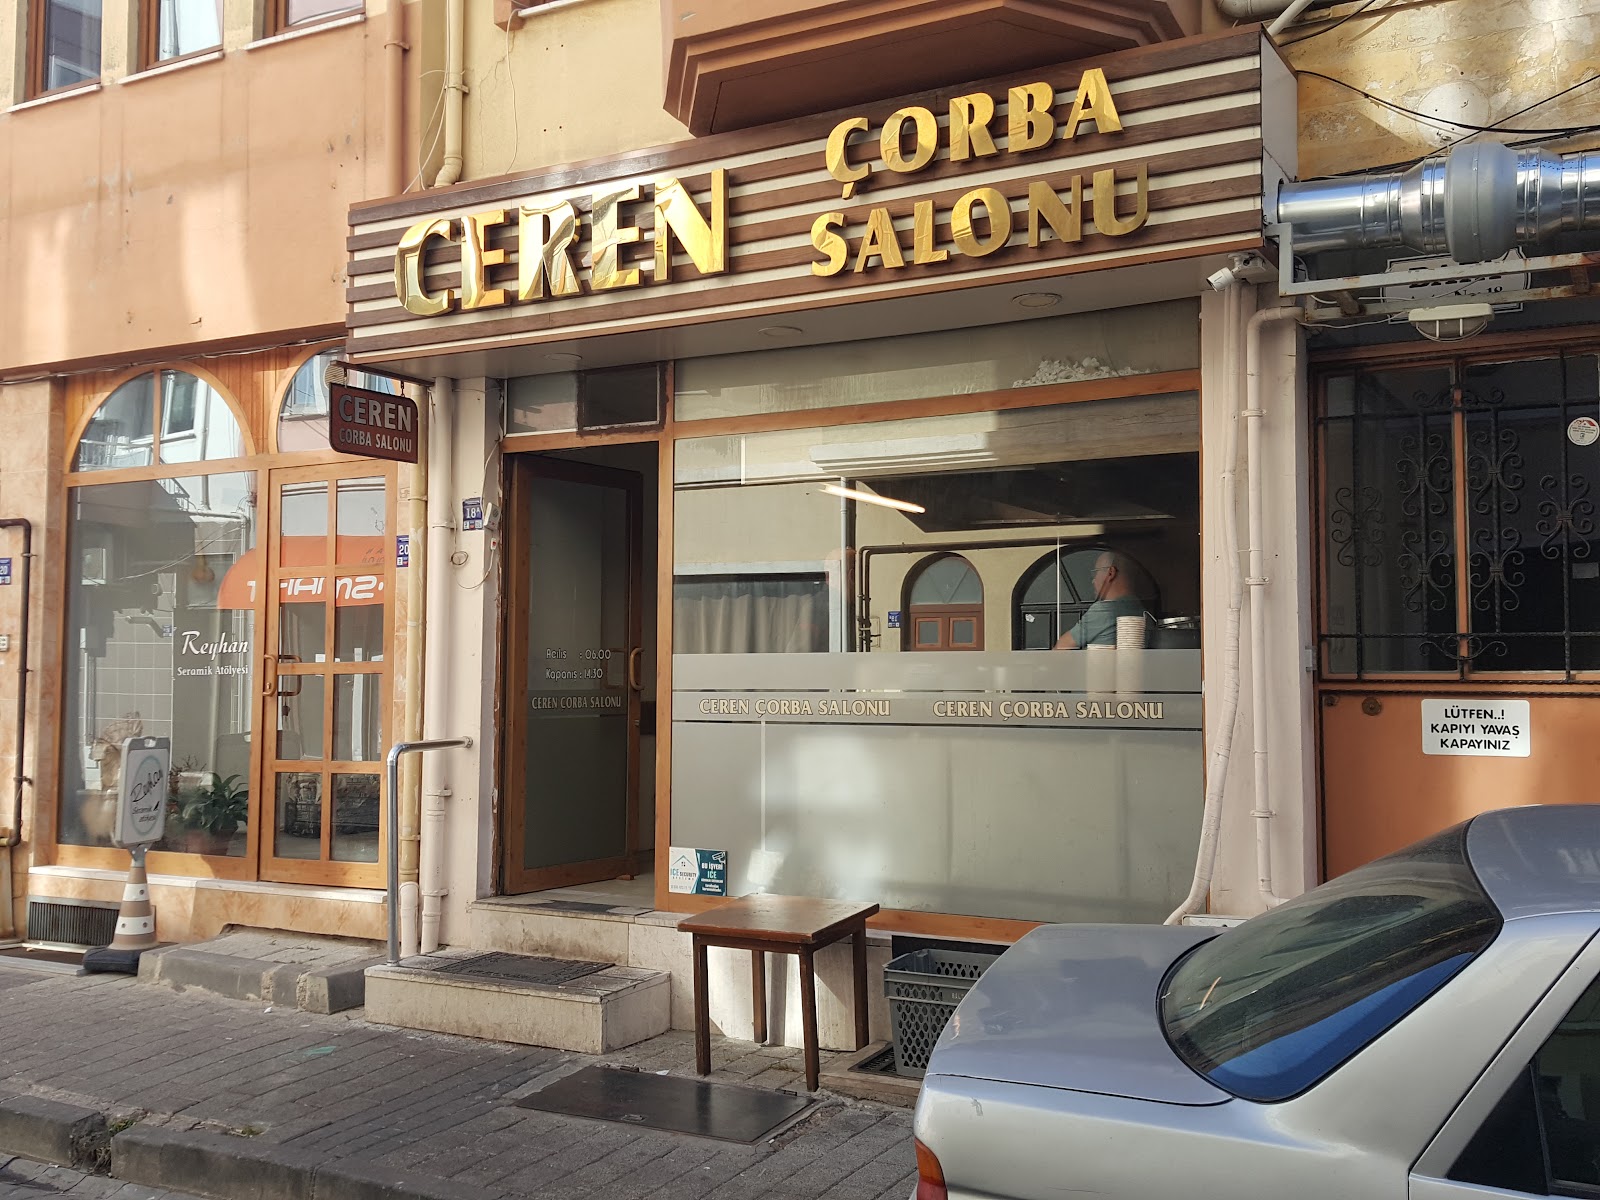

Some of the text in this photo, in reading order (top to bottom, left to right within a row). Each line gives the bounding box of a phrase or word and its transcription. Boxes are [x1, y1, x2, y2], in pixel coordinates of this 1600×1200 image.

[826, 67, 1123, 199] ÇORBA
[810, 163, 1150, 277] SALONU
[394, 168, 730, 316] CEREN
[338, 394, 412, 432] CEREN
[375, 433, 412, 453] SALONU
[181, 630, 249, 661] Reyhan
[585, 649, 611, 660] 06.00
[177, 666, 213, 676] Seramik
[532, 697, 558, 709] CEREN
[590, 696, 621, 708] SALONU
[699, 699, 891, 718] CEREN ÇORBA SALONU
[933, 700, 1164, 721] CEREN ÇORBA SALONU
[1444, 705, 1505, 720] LÜTFEN..!
[1430, 723, 1520, 739] KAPIYI YAVAŞ
[1440, 738, 1511, 751] KAPAYINIZ
[707, 870, 717, 878] ICE
